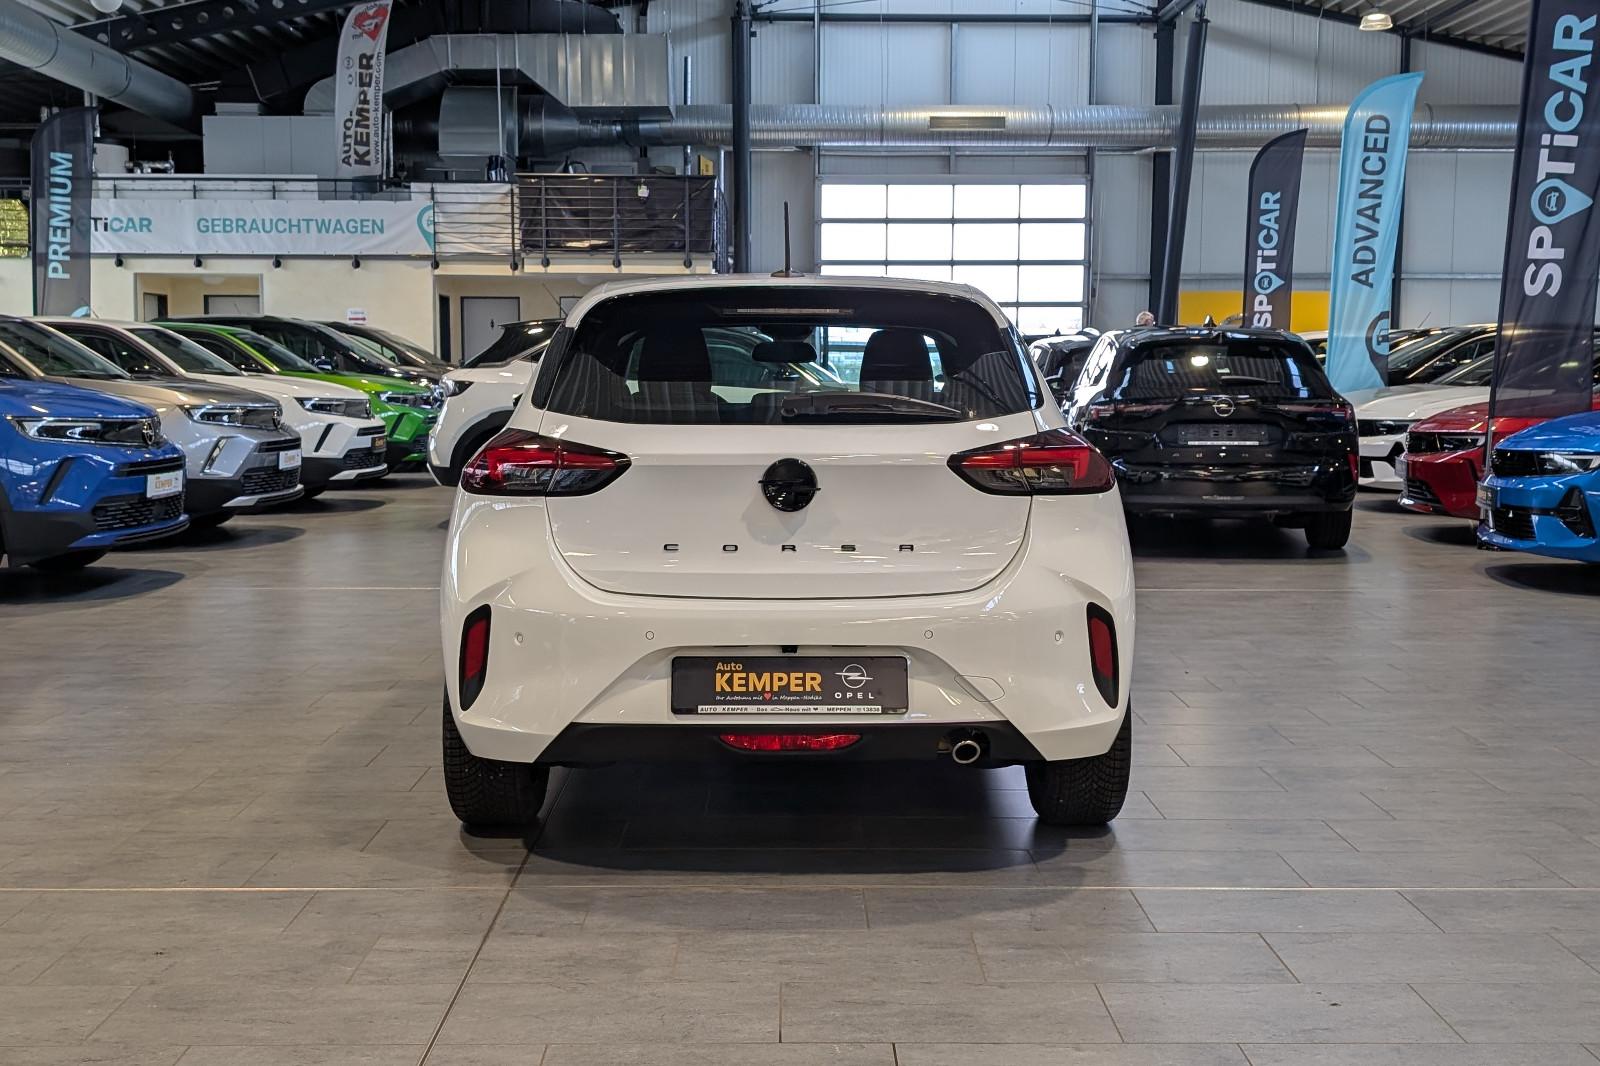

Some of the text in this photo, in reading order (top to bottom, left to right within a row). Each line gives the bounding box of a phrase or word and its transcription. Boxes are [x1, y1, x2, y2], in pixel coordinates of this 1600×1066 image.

[353, 53, 375, 167] KEMPER
[373, 51, 383, 165] www.auto-kemper.com
[1351, 114, 1391, 289] ADVANCED
[48, 151, 73, 280] PREMIUM
[196, 217, 385, 235] GEBRAUCHTWAGEN
[663, 543, 914, 552] CORSA
[716, 662, 743, 671] Auto
[715, 672, 822, 692] KEMPER
[834, 692, 875, 700] OPEL
